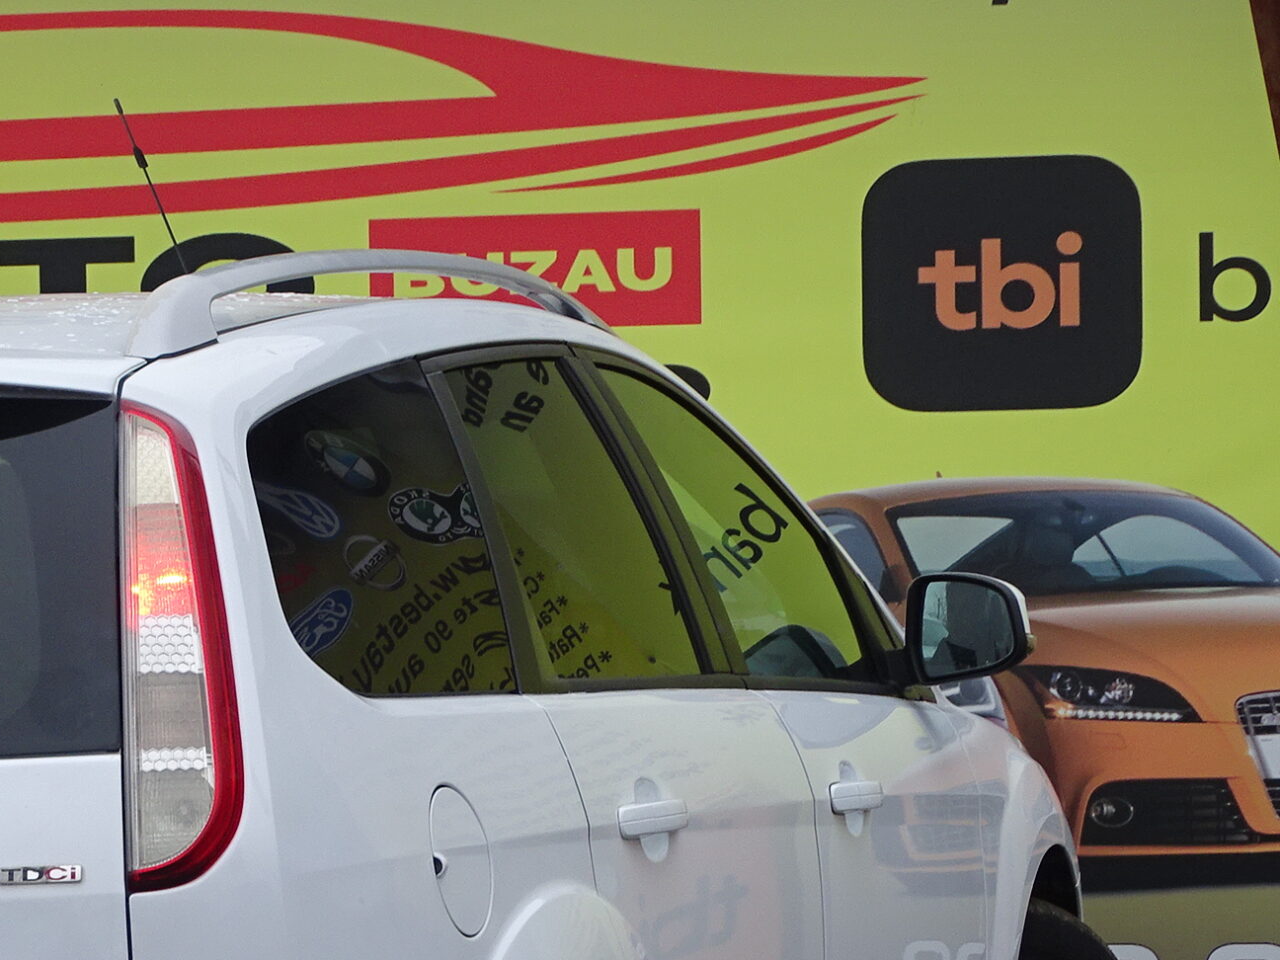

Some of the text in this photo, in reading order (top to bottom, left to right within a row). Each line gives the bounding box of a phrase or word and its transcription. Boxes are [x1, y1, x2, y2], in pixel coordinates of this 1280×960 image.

[393, 247, 672, 298] BUZAU
[917, 231, 1083, 331] tbi
[1, 866, 78, 882] TDCi
